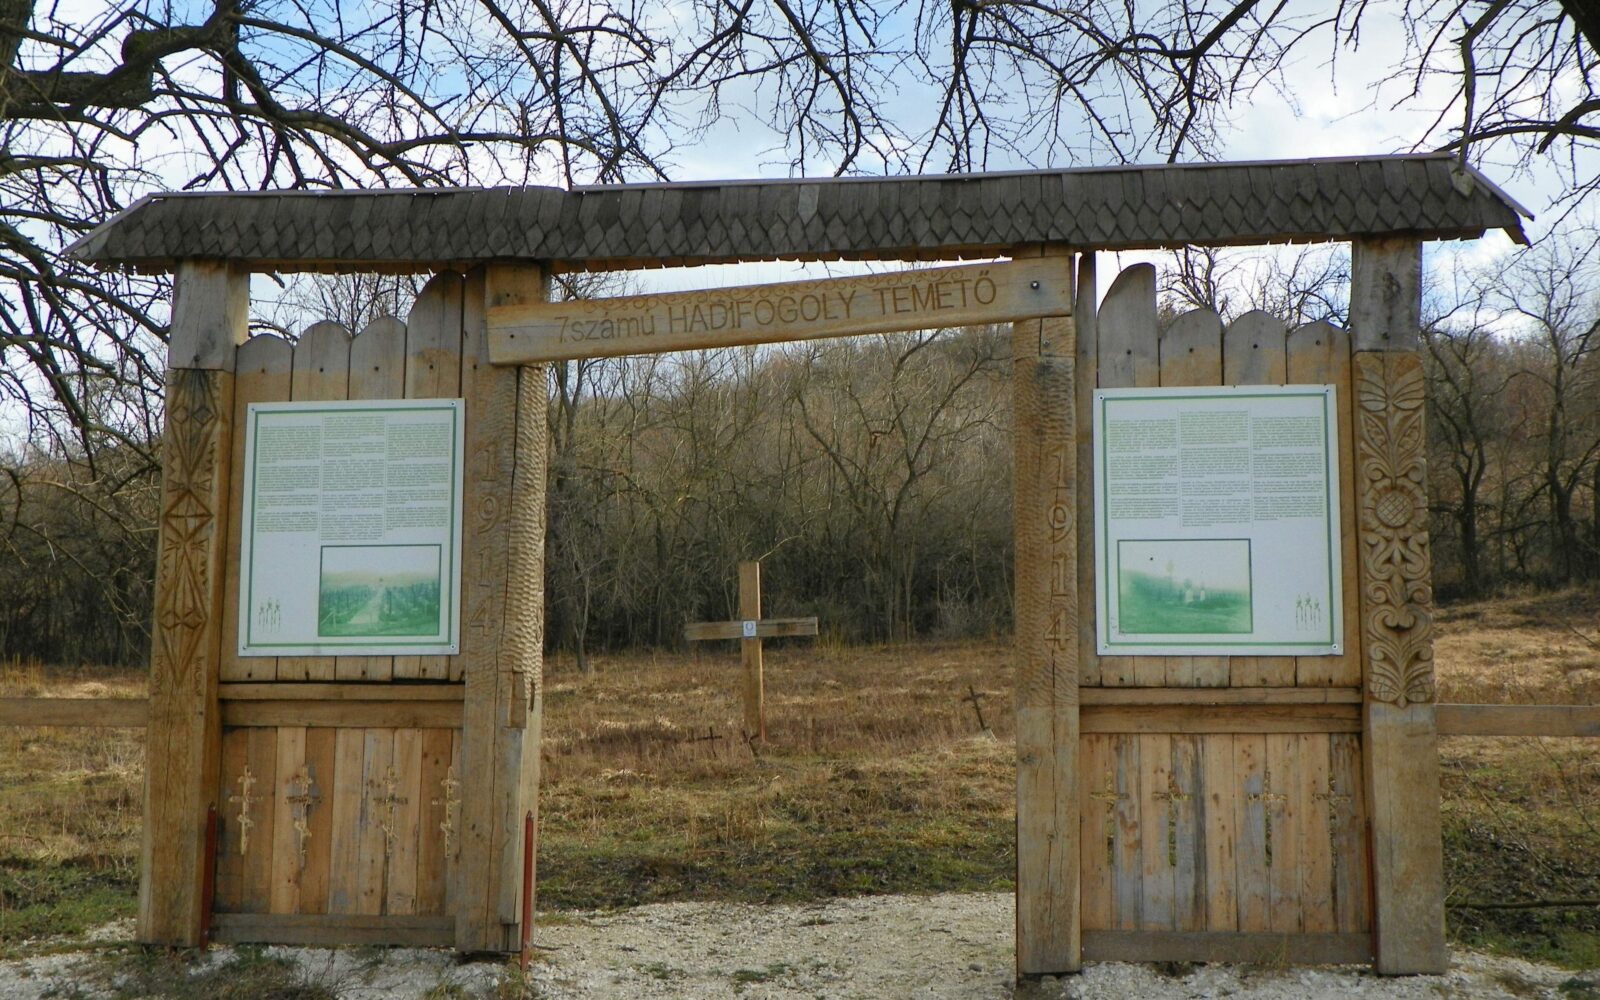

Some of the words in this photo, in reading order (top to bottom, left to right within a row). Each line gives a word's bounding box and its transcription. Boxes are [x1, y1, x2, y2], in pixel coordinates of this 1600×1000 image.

[668, 290, 855, 334] HADIFOGOLY
[873, 270, 997, 315] TEMETŐ
[469, 444, 500, 637] 1914
[1044, 446, 1073, 651] 1914
